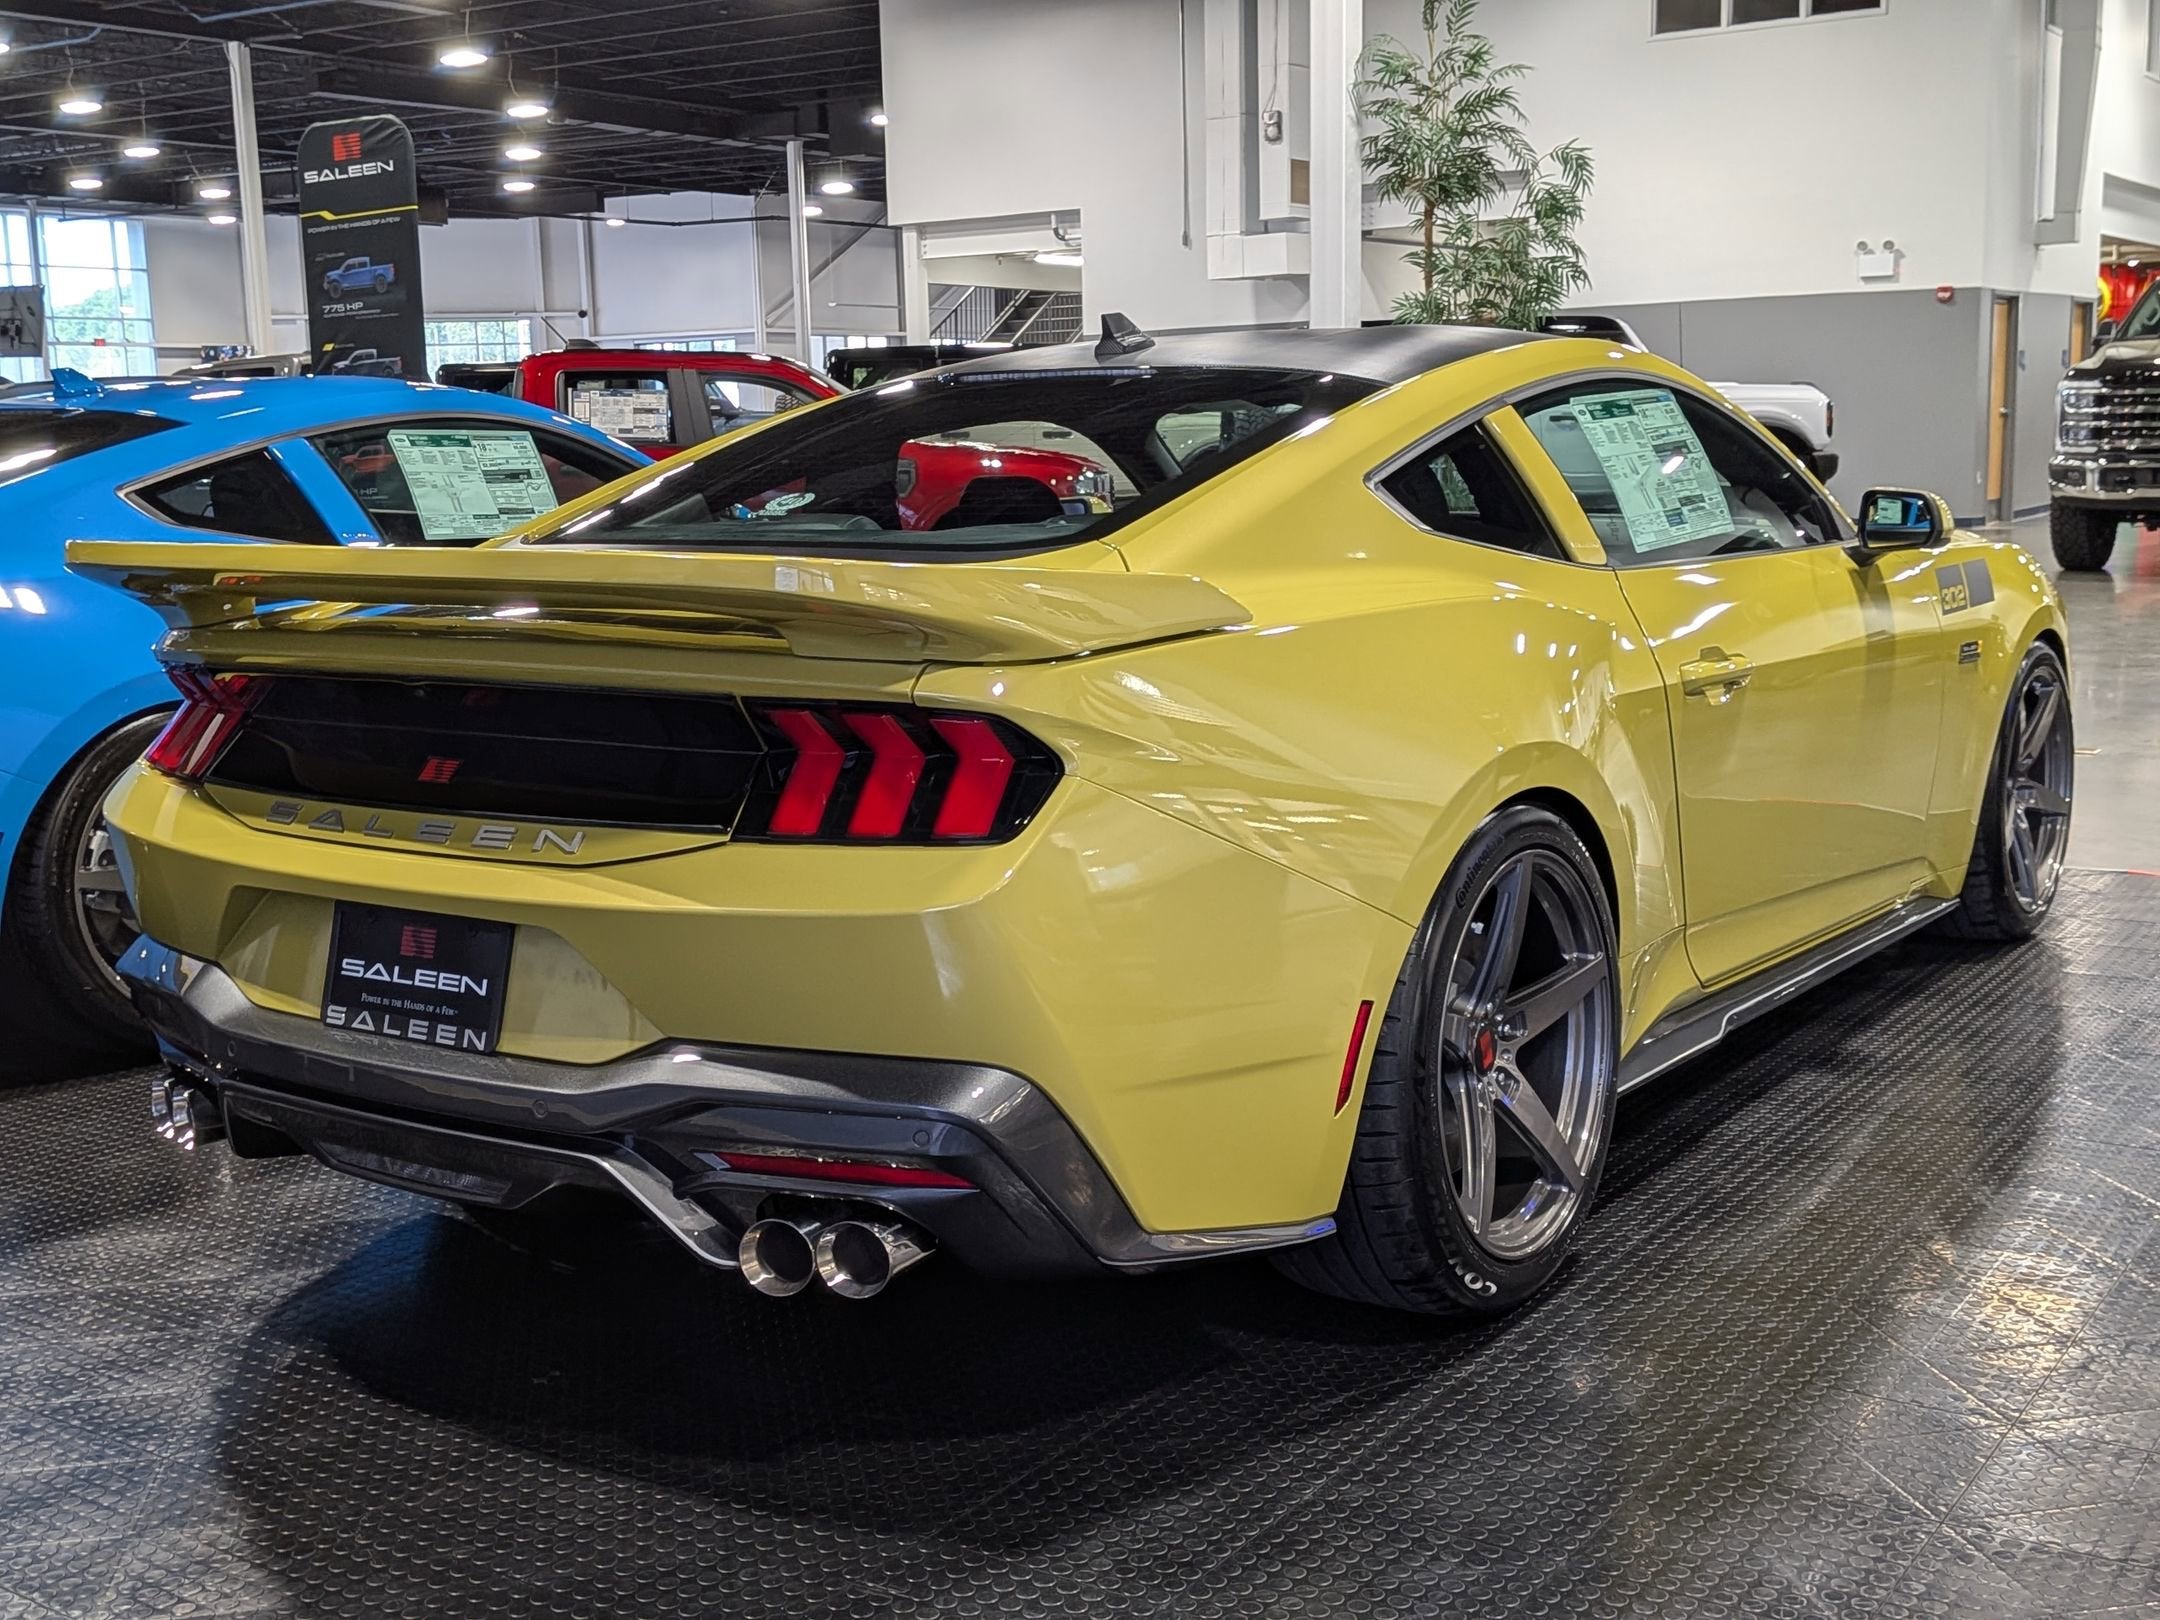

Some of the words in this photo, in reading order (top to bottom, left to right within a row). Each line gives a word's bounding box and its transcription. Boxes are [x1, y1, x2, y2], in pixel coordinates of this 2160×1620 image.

[304, 160, 394, 184] SALEEN
[322, 303, 345, 313] 775
[346, 301, 364, 311] HP
[1941, 586, 1967, 610] 302
[266, 801, 586, 855] SALEEN
[341, 958, 488, 996] SALEEN
[325, 1004, 487, 1051] SALEEN
